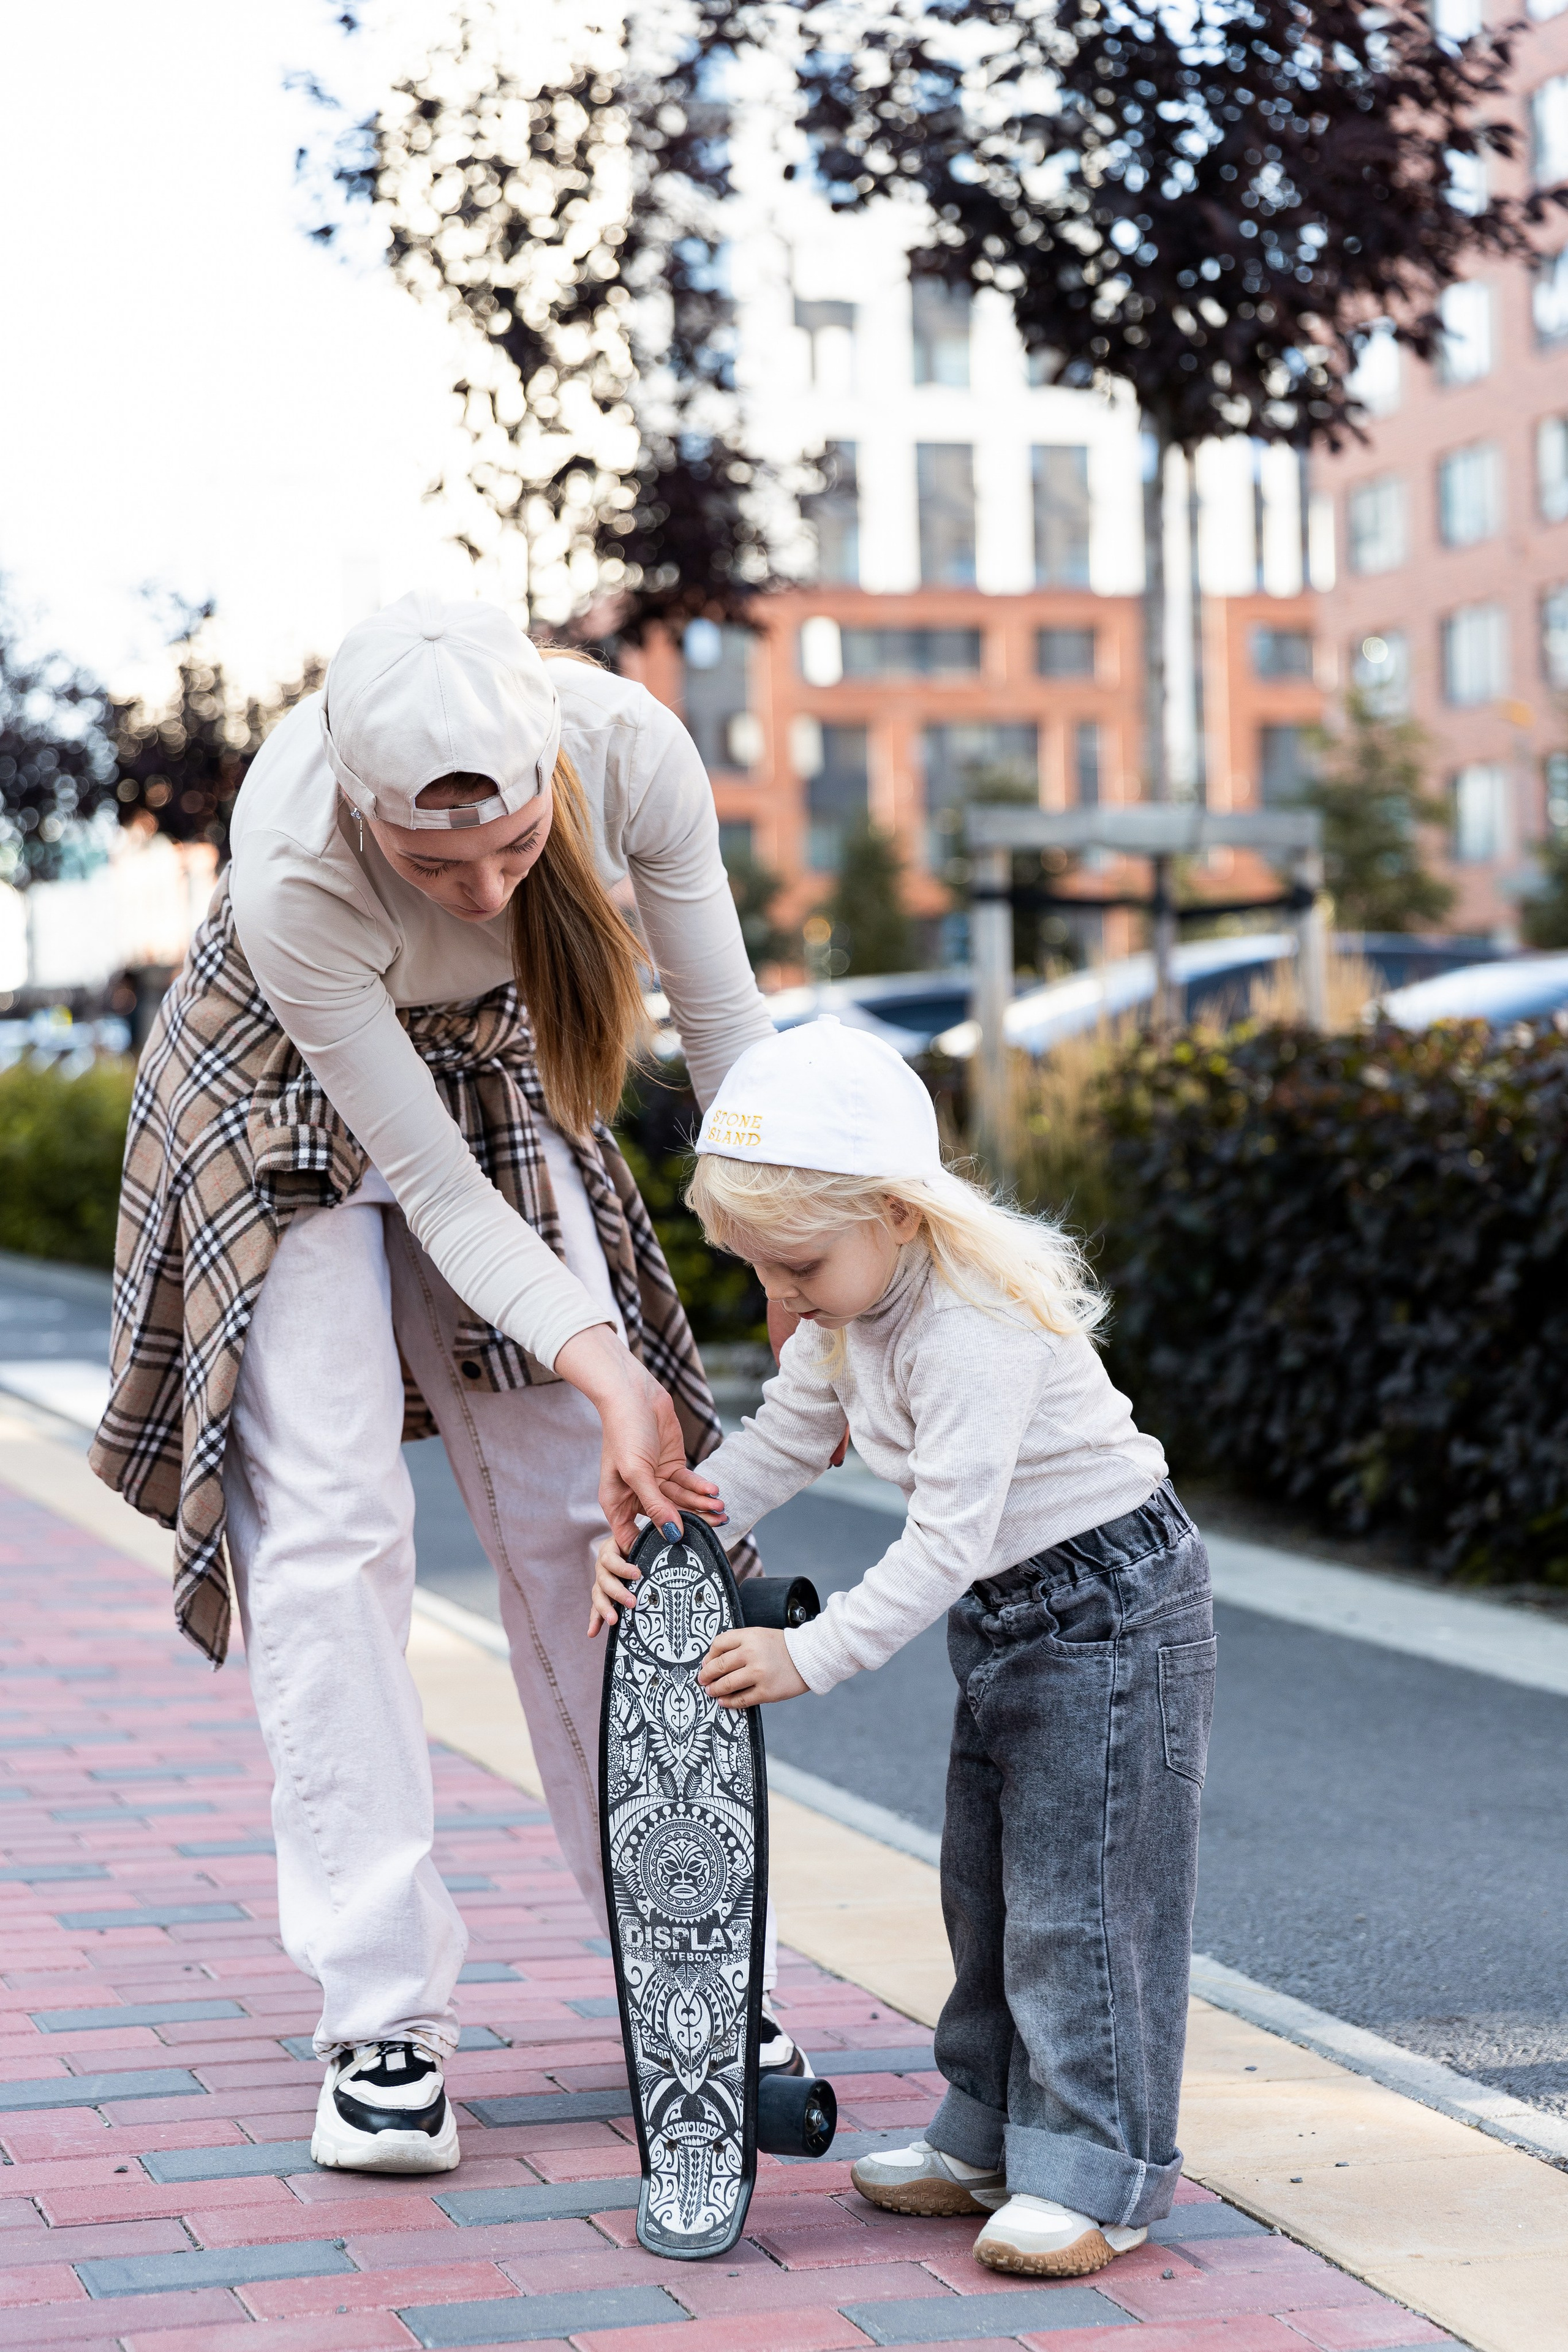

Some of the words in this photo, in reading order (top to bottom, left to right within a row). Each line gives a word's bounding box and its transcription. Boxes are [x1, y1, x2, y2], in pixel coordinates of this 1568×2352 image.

[713, 1110, 763, 1129] STONE
[625, 1926, 745, 1951] DISPLAY
[647, 1951, 729, 1962] SKATEBOARD
